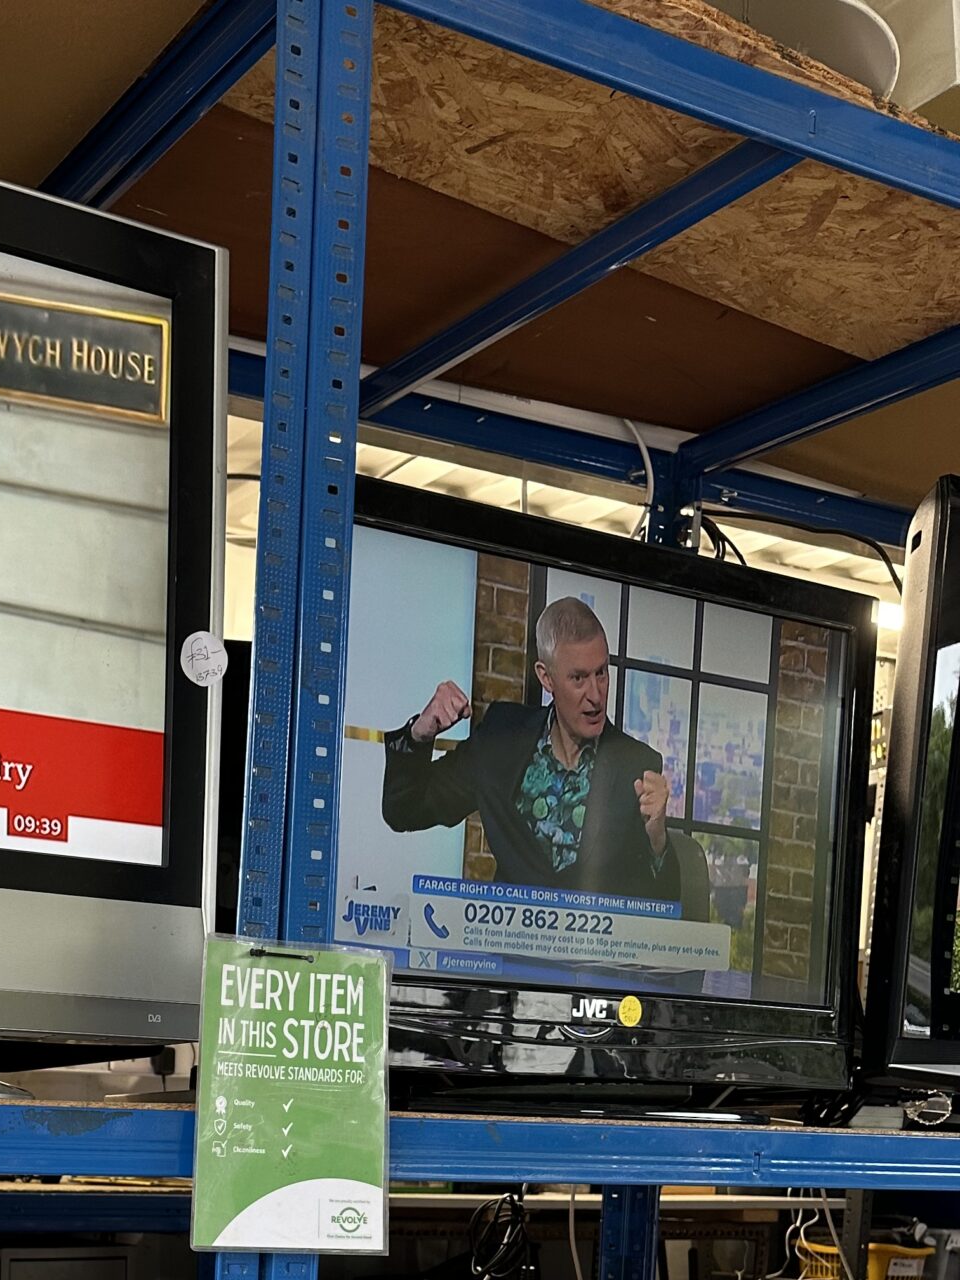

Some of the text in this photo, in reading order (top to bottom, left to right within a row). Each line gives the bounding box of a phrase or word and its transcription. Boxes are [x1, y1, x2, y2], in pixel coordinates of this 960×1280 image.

[72, 337, 156, 384] HOUSE
[13, 813, 62, 837] 09:39
[419, 879, 457, 892] FARAGE
[460, 883, 488, 895] RIGHT
[491, 886, 504, 896] TO
[506, 887, 529, 899] CALL
[531, 890, 559, 902] BORIS
[599, 897, 625, 909] PRIME
[343, 900, 401, 922] JEREMY
[464, 902, 613, 935] 0207 862 2222
[354, 916, 391, 936] VINE
[463, 937, 482, 946] Calls
[484, 938, 502, 948] from
[504, 940, 534, 951] mobiles
[535, 944, 551, 954] may
[553, 945, 569, 954] cost
[570, 945, 616, 959] considerably
[464, 926, 482, 936] Calls
[485, 928, 503, 937] from
[505, 929, 538, 940] landlines
[541, 934, 556, 943] may
[558, 934, 574, 944] cost
[575, 937, 585, 946] up
[586, 937, 594, 945] to
[610, 940, 622, 950] per
[652, 942, 666, 953] plus
[668, 945, 680, 955] any
[442, 954, 497, 970] #jeremyvine
[221, 964, 365, 1017] EVERY ITEM
[572, 998, 608, 1018] JVC
[218, 1017, 366, 1063] IN THIS STORE
[217, 1061, 366, 1084] MEETS REVOLVE STANDARDS FOR:
[233, 1099, 255, 1109] Quality
[233, 1122, 252, 1132] Safety
[331, 1213, 368, 1225] REVOLVE
